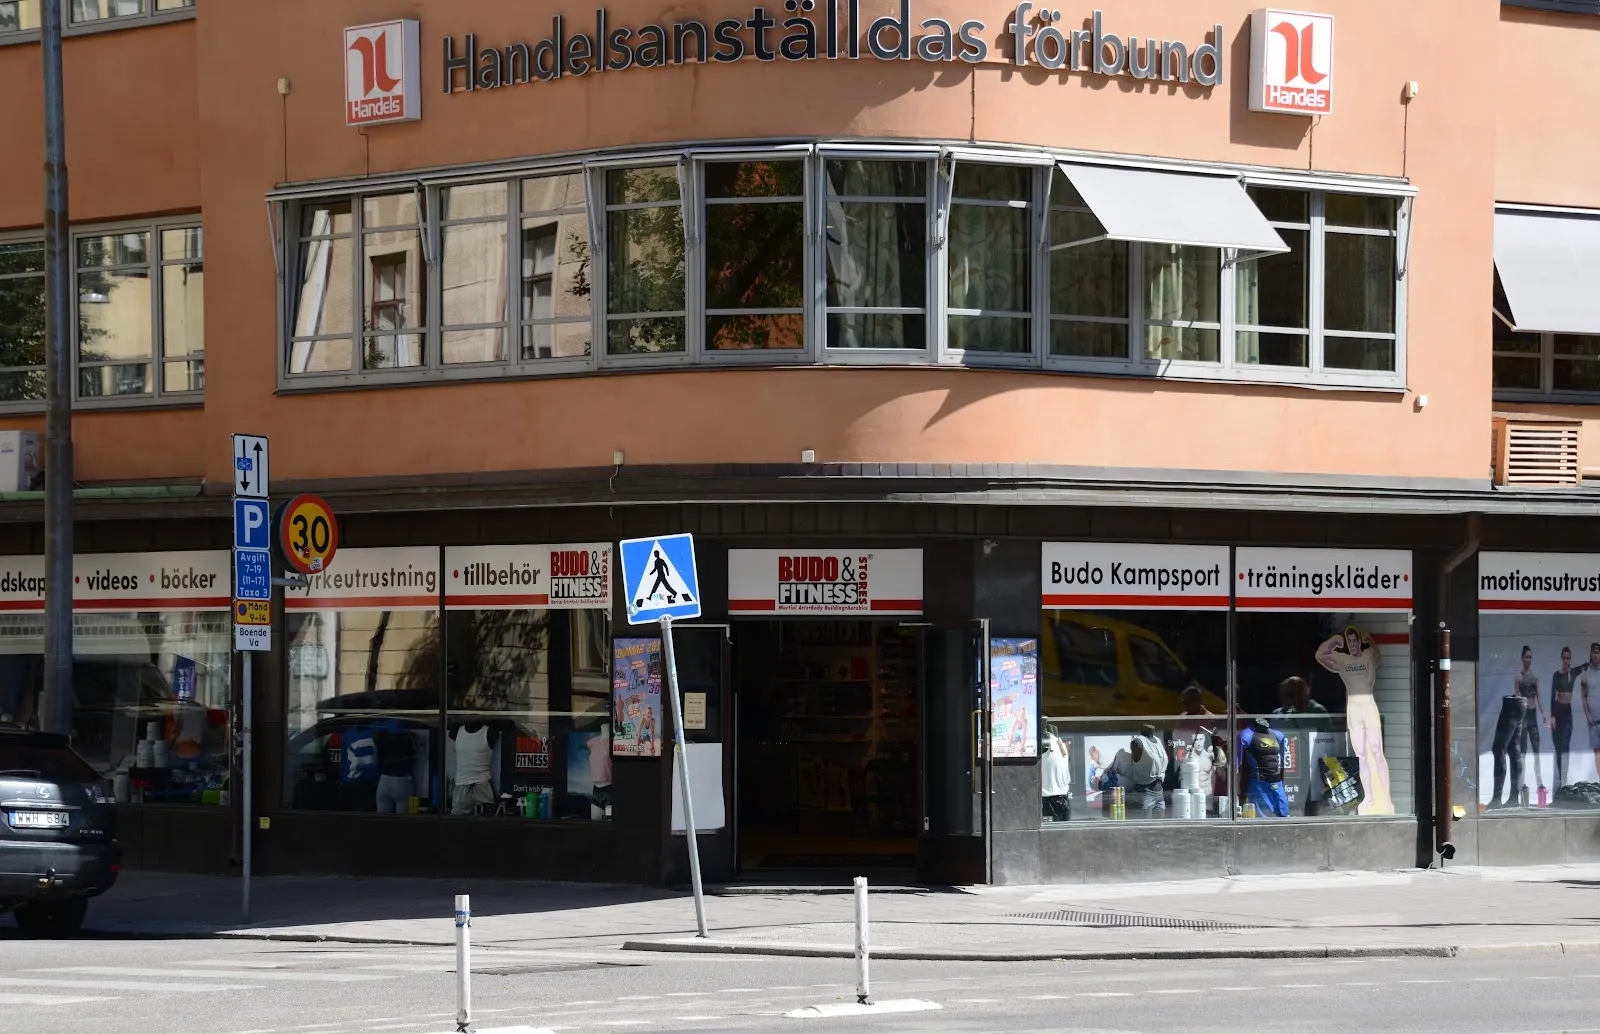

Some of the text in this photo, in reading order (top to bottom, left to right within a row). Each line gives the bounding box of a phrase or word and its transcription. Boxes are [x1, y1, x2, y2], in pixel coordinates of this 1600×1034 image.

[443, 0, 1224, 94] Handelsanställdas förbund
[1269, 85, 1326, 107] Handels
[352, 96, 400, 119] Handels
[243, 504, 263, 544] P
[293, 514, 329, 553] 30
[240, 552, 266, 564] Avgift
[245, 564, 262, 573] 7-19
[551, 551, 600, 576] BUDO &
[779, 556, 856, 581] BUDO &
[87, 569, 138, 590] videos
[161, 567, 217, 589] böcker
[242, 575, 265, 585] (11-17)
[289, 563, 436, 596] syrkeutrustning
[463, 562, 541, 585] tillbehör
[859, 556, 868, 604] STORES
[1051, 561, 1220, 591] Budo Kampsport
[1247, 565, 1400, 595] träningskläder
[240, 587, 268, 597] Taxa 3
[552, 577, 601, 598] FITNESS
[780, 583, 858, 603] FITNESS
[248, 602, 268, 611] Månd
[250, 613, 266, 622] 9-14
[240, 627, 267, 637] Boende
[249, 638, 259, 647] Va
[516, 754, 548, 767] FITNESS
[17, 811, 67, 824] WWH 684
